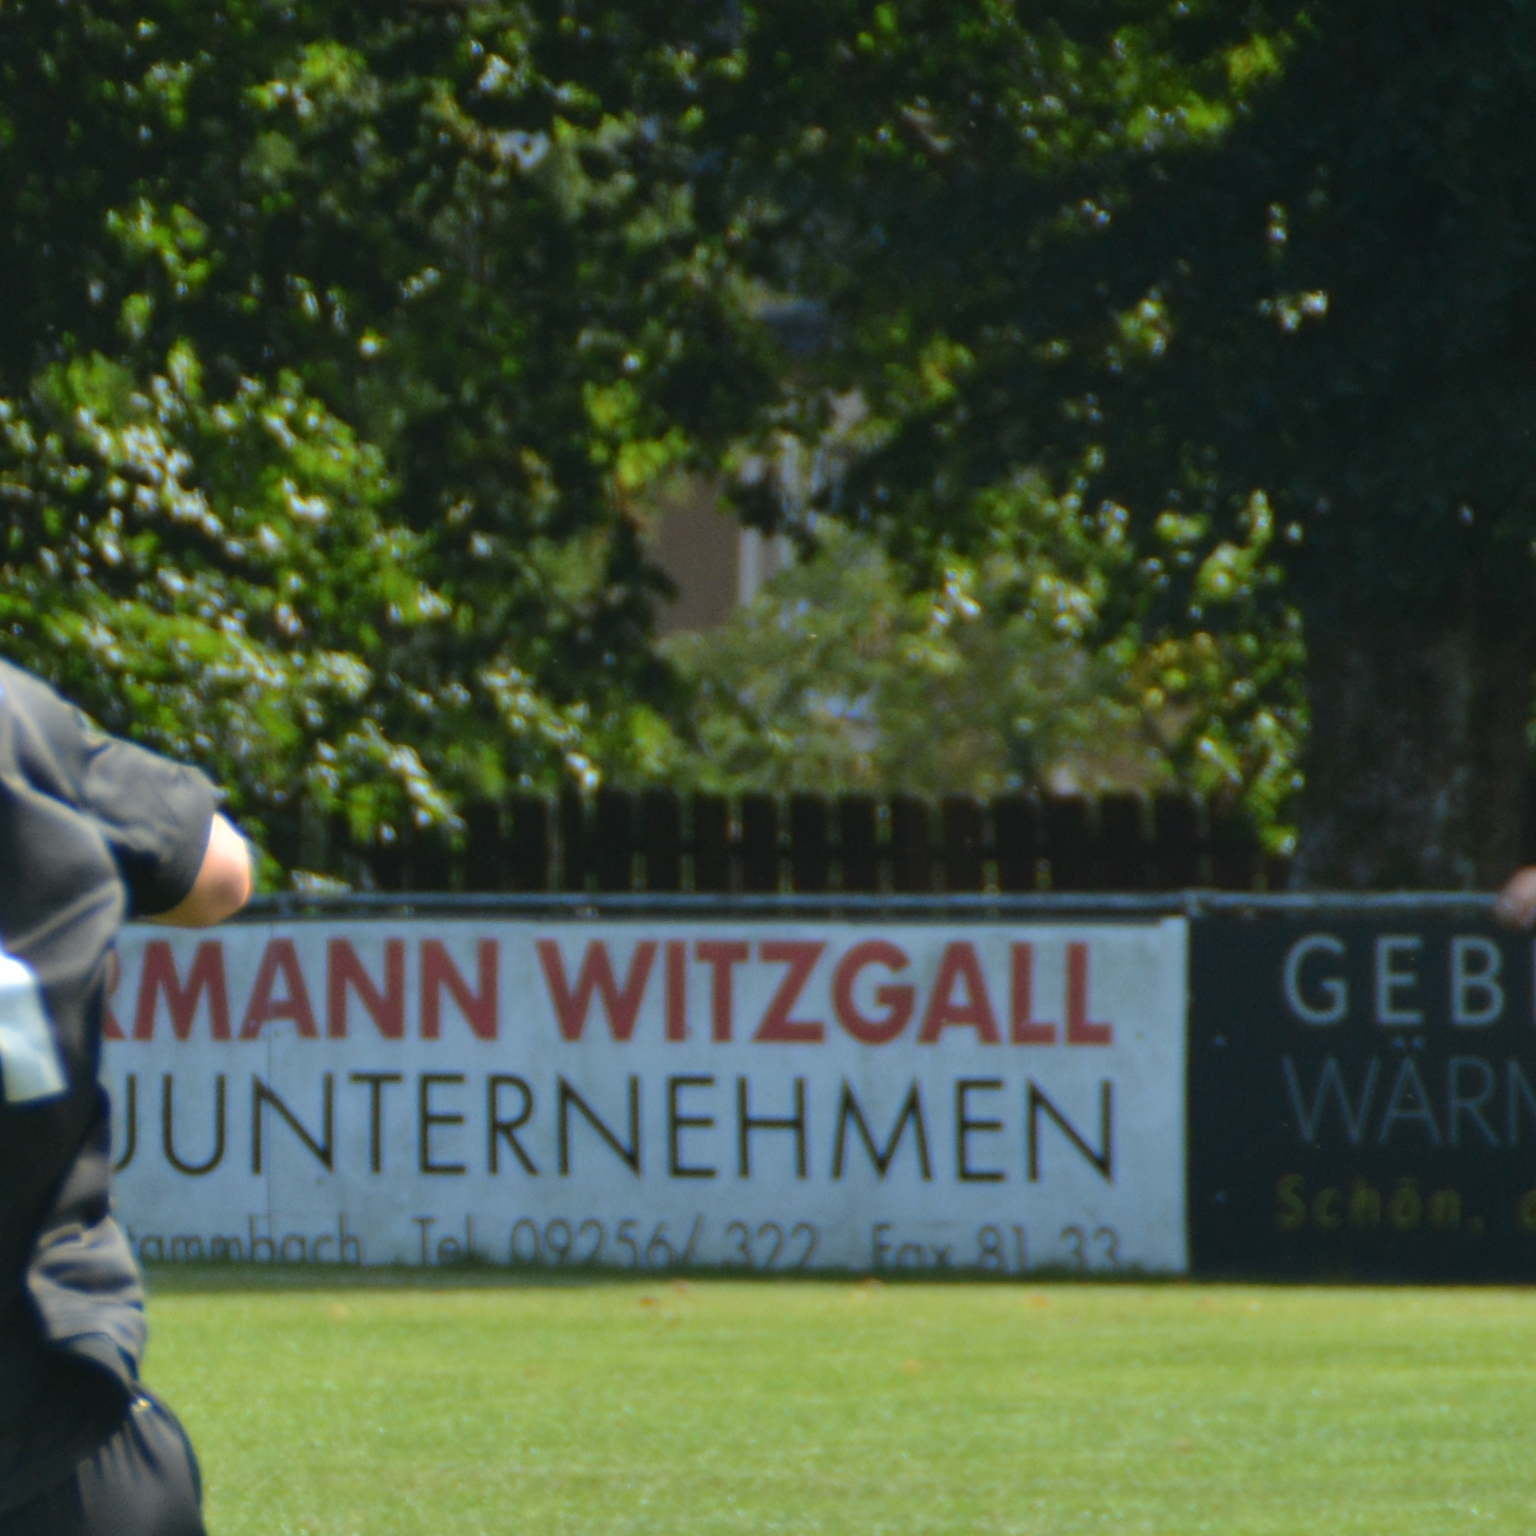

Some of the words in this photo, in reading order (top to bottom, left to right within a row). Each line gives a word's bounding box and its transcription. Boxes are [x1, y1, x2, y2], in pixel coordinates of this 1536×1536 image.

[535, 938, 1114, 1046] WITZGALL
[1284, 934, 1536, 1026] GEB
[128, 1212, 362, 1265] ammbach
